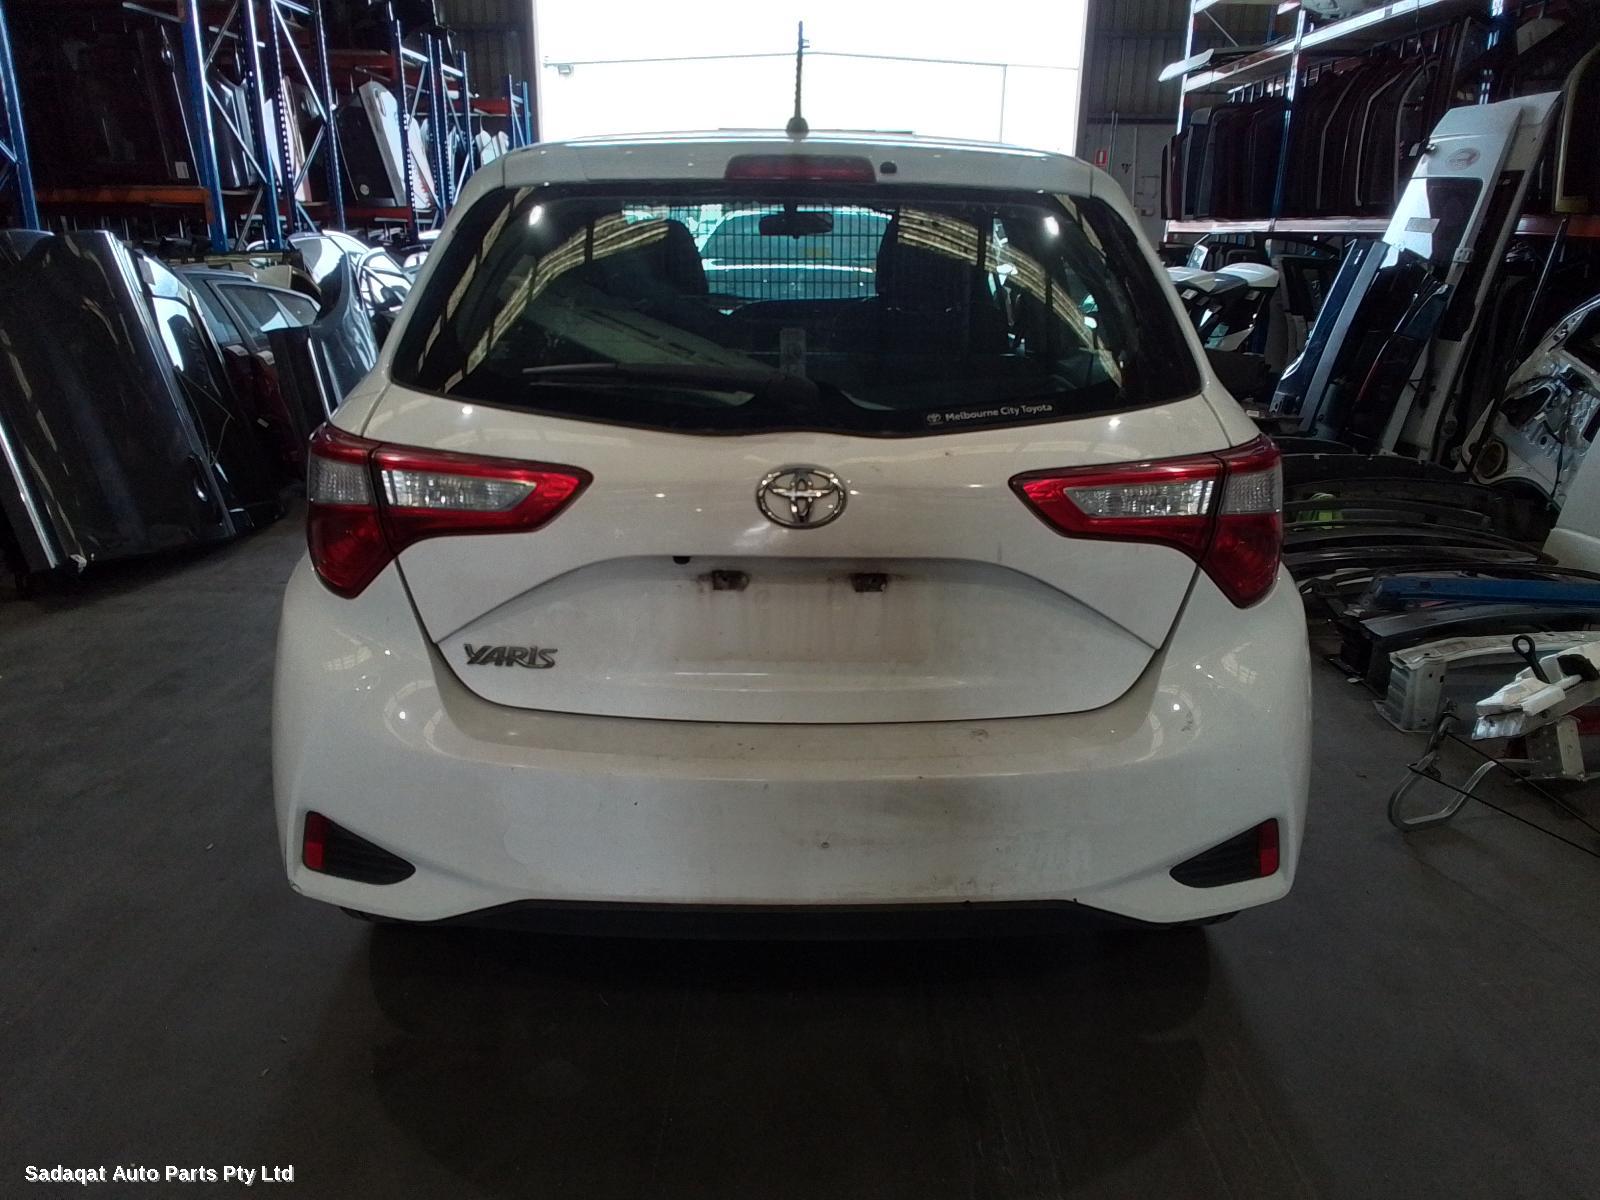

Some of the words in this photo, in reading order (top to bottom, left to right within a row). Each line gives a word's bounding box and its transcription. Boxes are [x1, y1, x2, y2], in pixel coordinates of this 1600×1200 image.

[945, 410, 998, 421] Melbourne
[1000, 407, 1019, 416] City
[1021, 405, 1052, 415] Toyota
[464, 644, 558, 669] YARIS
